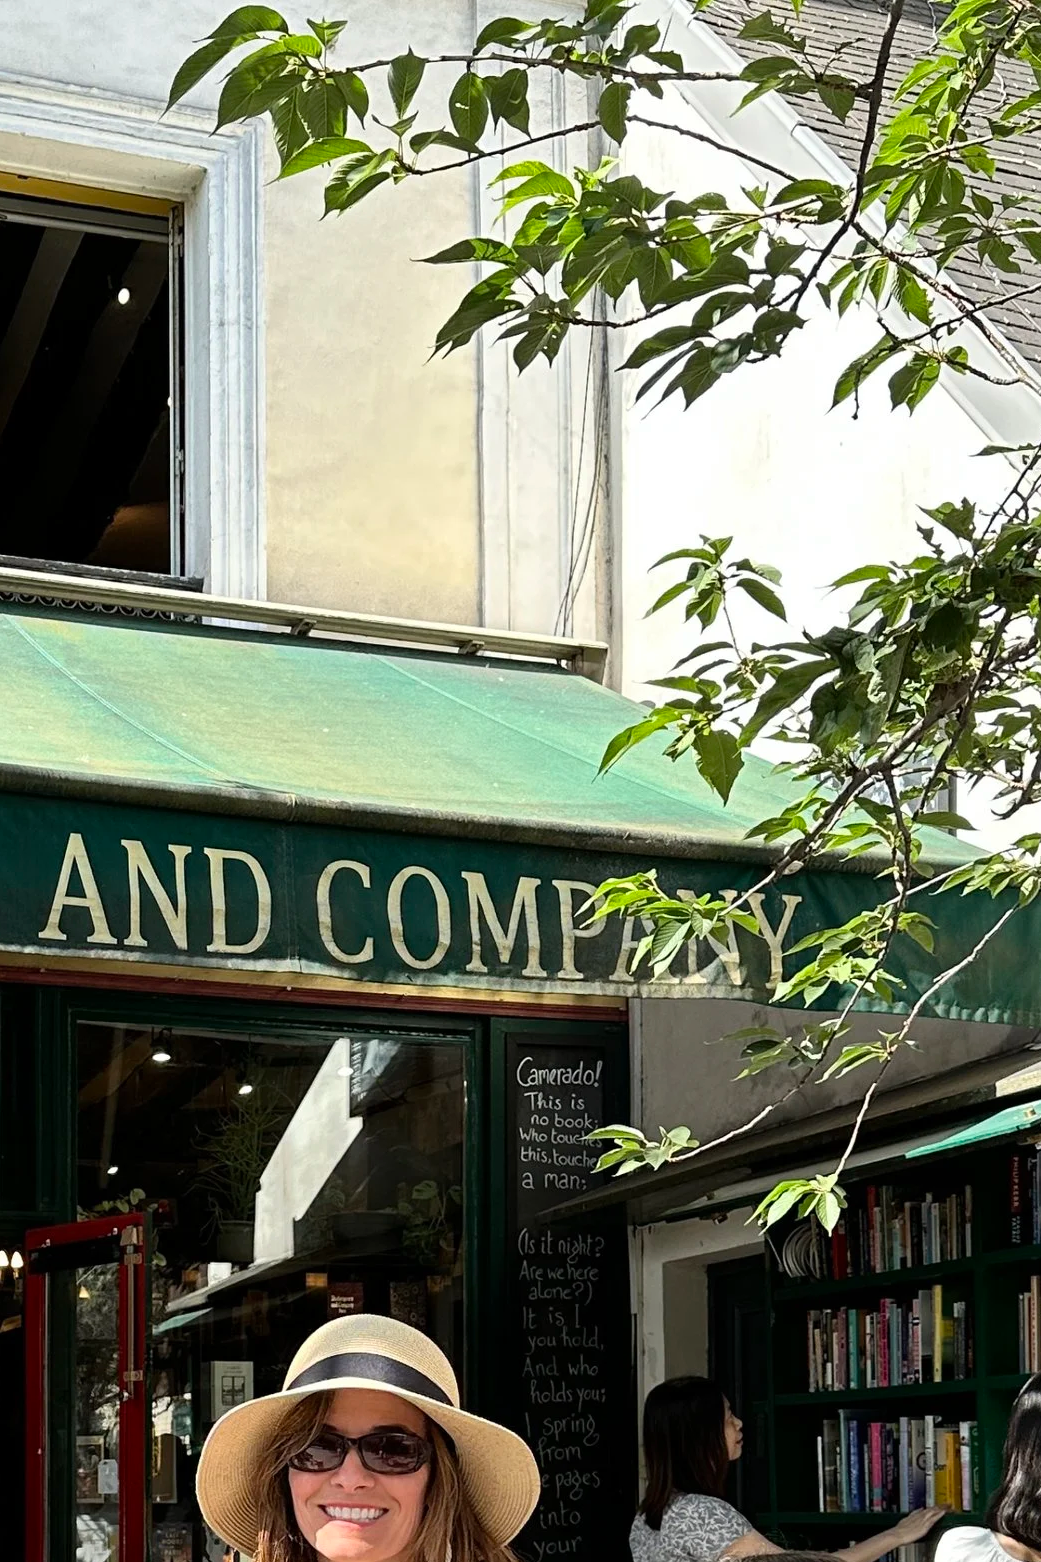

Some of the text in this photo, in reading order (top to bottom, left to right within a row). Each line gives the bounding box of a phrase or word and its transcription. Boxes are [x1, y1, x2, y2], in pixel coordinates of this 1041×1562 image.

[38, 832, 272, 954] AND
[516, 1056, 603, 1088] Camerado!
[523, 1091, 586, 1111] This is
[519, 1127, 548, 1142] Who
[530, 1113, 599, 1130] no book;
[520, 1146, 599, 1168] this, touche
[521, 1172, 587, 1190] a man;
[541, 1230, 554, 1255] it
[558, 1234, 605, 1264] night?
[518, 1259, 599, 1281] Are we here
[528, 1281, 593, 1306] alone?)
[523, 1303, 581, 1329] It is I
[524, 1325, 605, 1356] you hold,
[522, 1353, 599, 1378] And who
[530, 1379, 606, 1413] holds you;
[524, 1412, 600, 1447] I spring
[537, 1437, 582, 1467] from
[555, 1469, 601, 1501] pages
[540, 1501, 582, 1529] into
